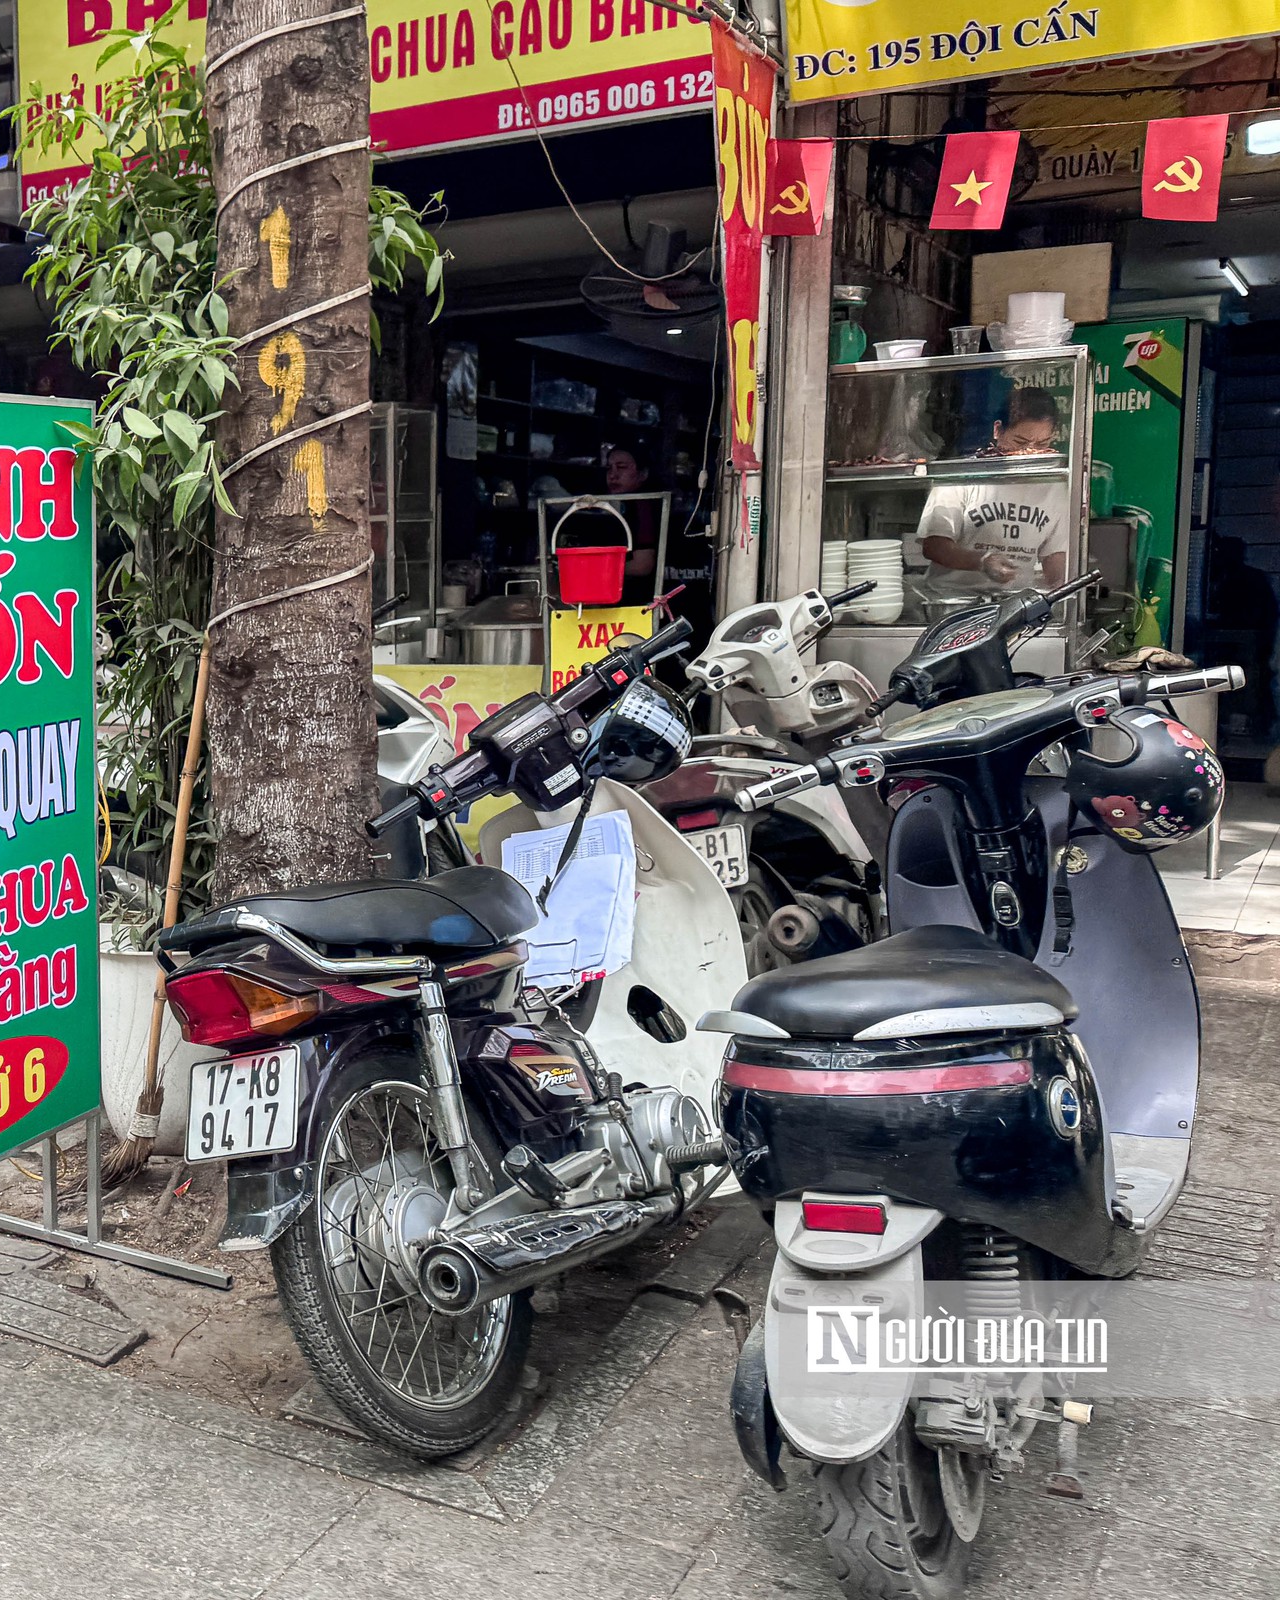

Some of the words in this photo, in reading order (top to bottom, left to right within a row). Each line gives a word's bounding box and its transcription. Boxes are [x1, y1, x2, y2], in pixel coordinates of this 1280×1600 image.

[370, 8, 475, 84] CHUA
[794, 53, 857, 81] ĐC:
[867, 36, 922, 72] 195
[930, 21, 1003, 64] ĐỘI
[1013, 0, 1099, 47] CẤN
[497, 103, 532, 130] Đt:
[537, 89, 601, 124] 0965
[607, 81, 657, 111] 006
[664, 70, 714, 103] 132
[1002, 524, 1020, 539] TO
[577, 622, 625, 649] XAY
[23, 1046, 47, 1104] 6
[206, 1055, 281, 1107] 17-K8
[200, 1101, 280, 1154] 9417
